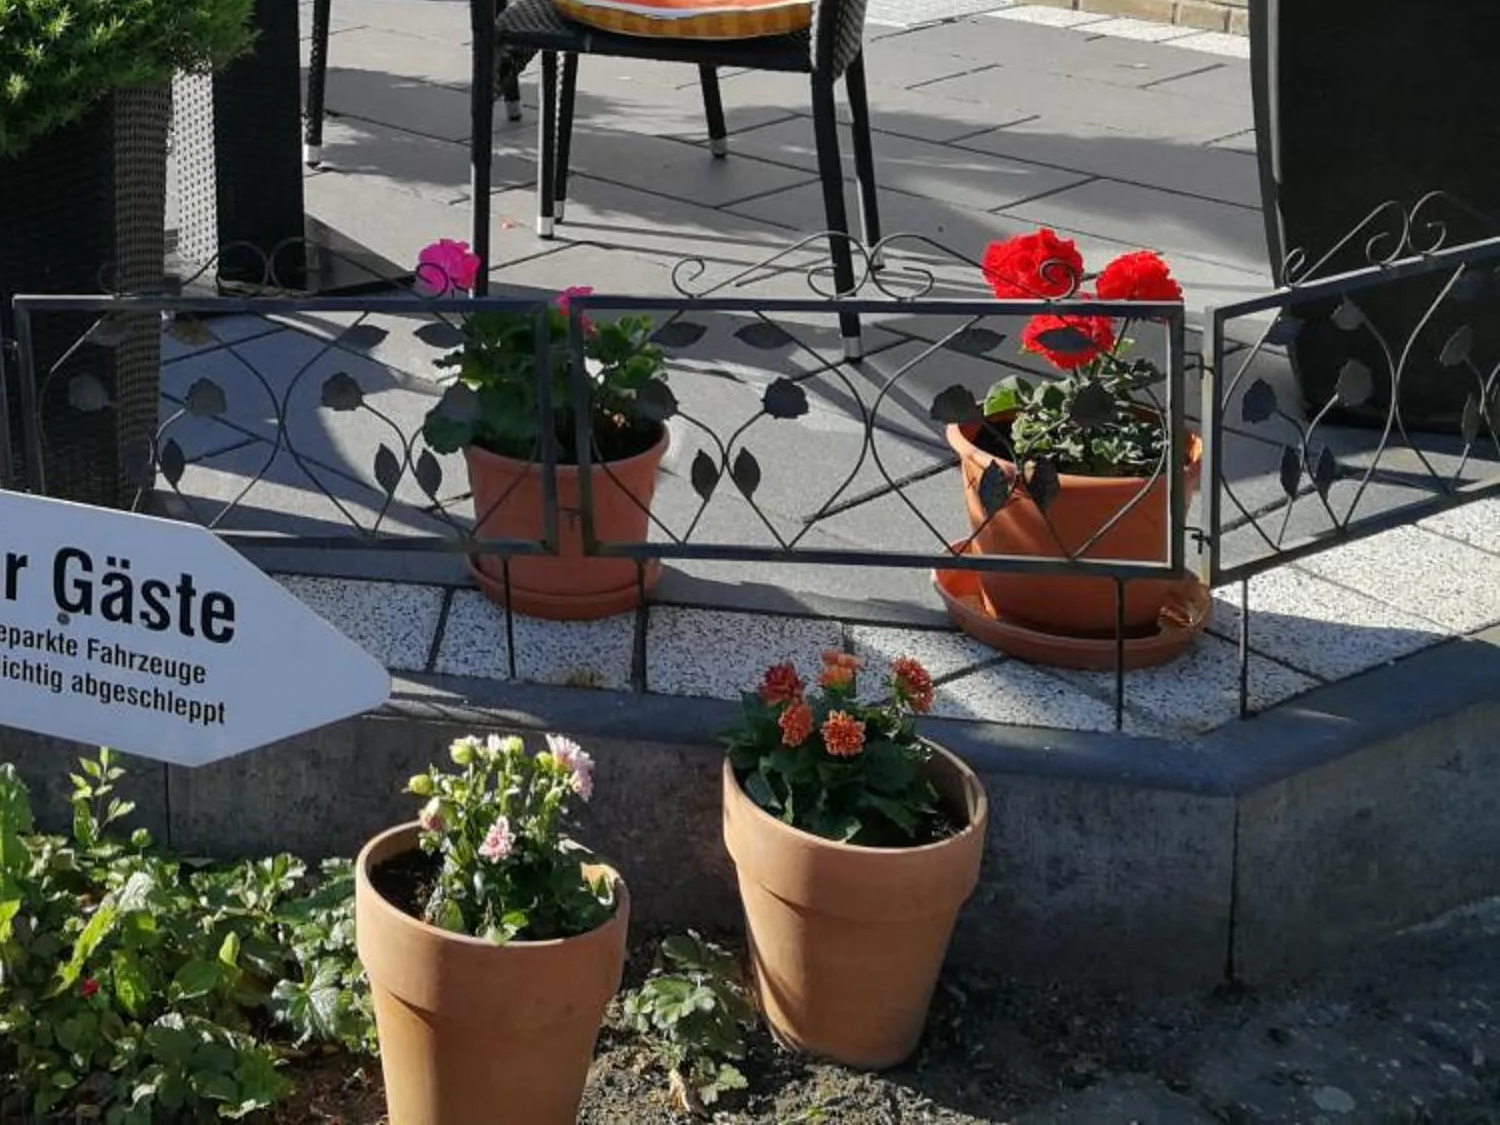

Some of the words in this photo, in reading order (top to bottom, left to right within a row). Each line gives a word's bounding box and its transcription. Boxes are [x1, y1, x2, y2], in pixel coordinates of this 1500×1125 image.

[53, 546, 235, 644] Gäste
[87, 638, 206, 686] Fahrzeuge
[71, 672, 225, 725] abgeschleppt
